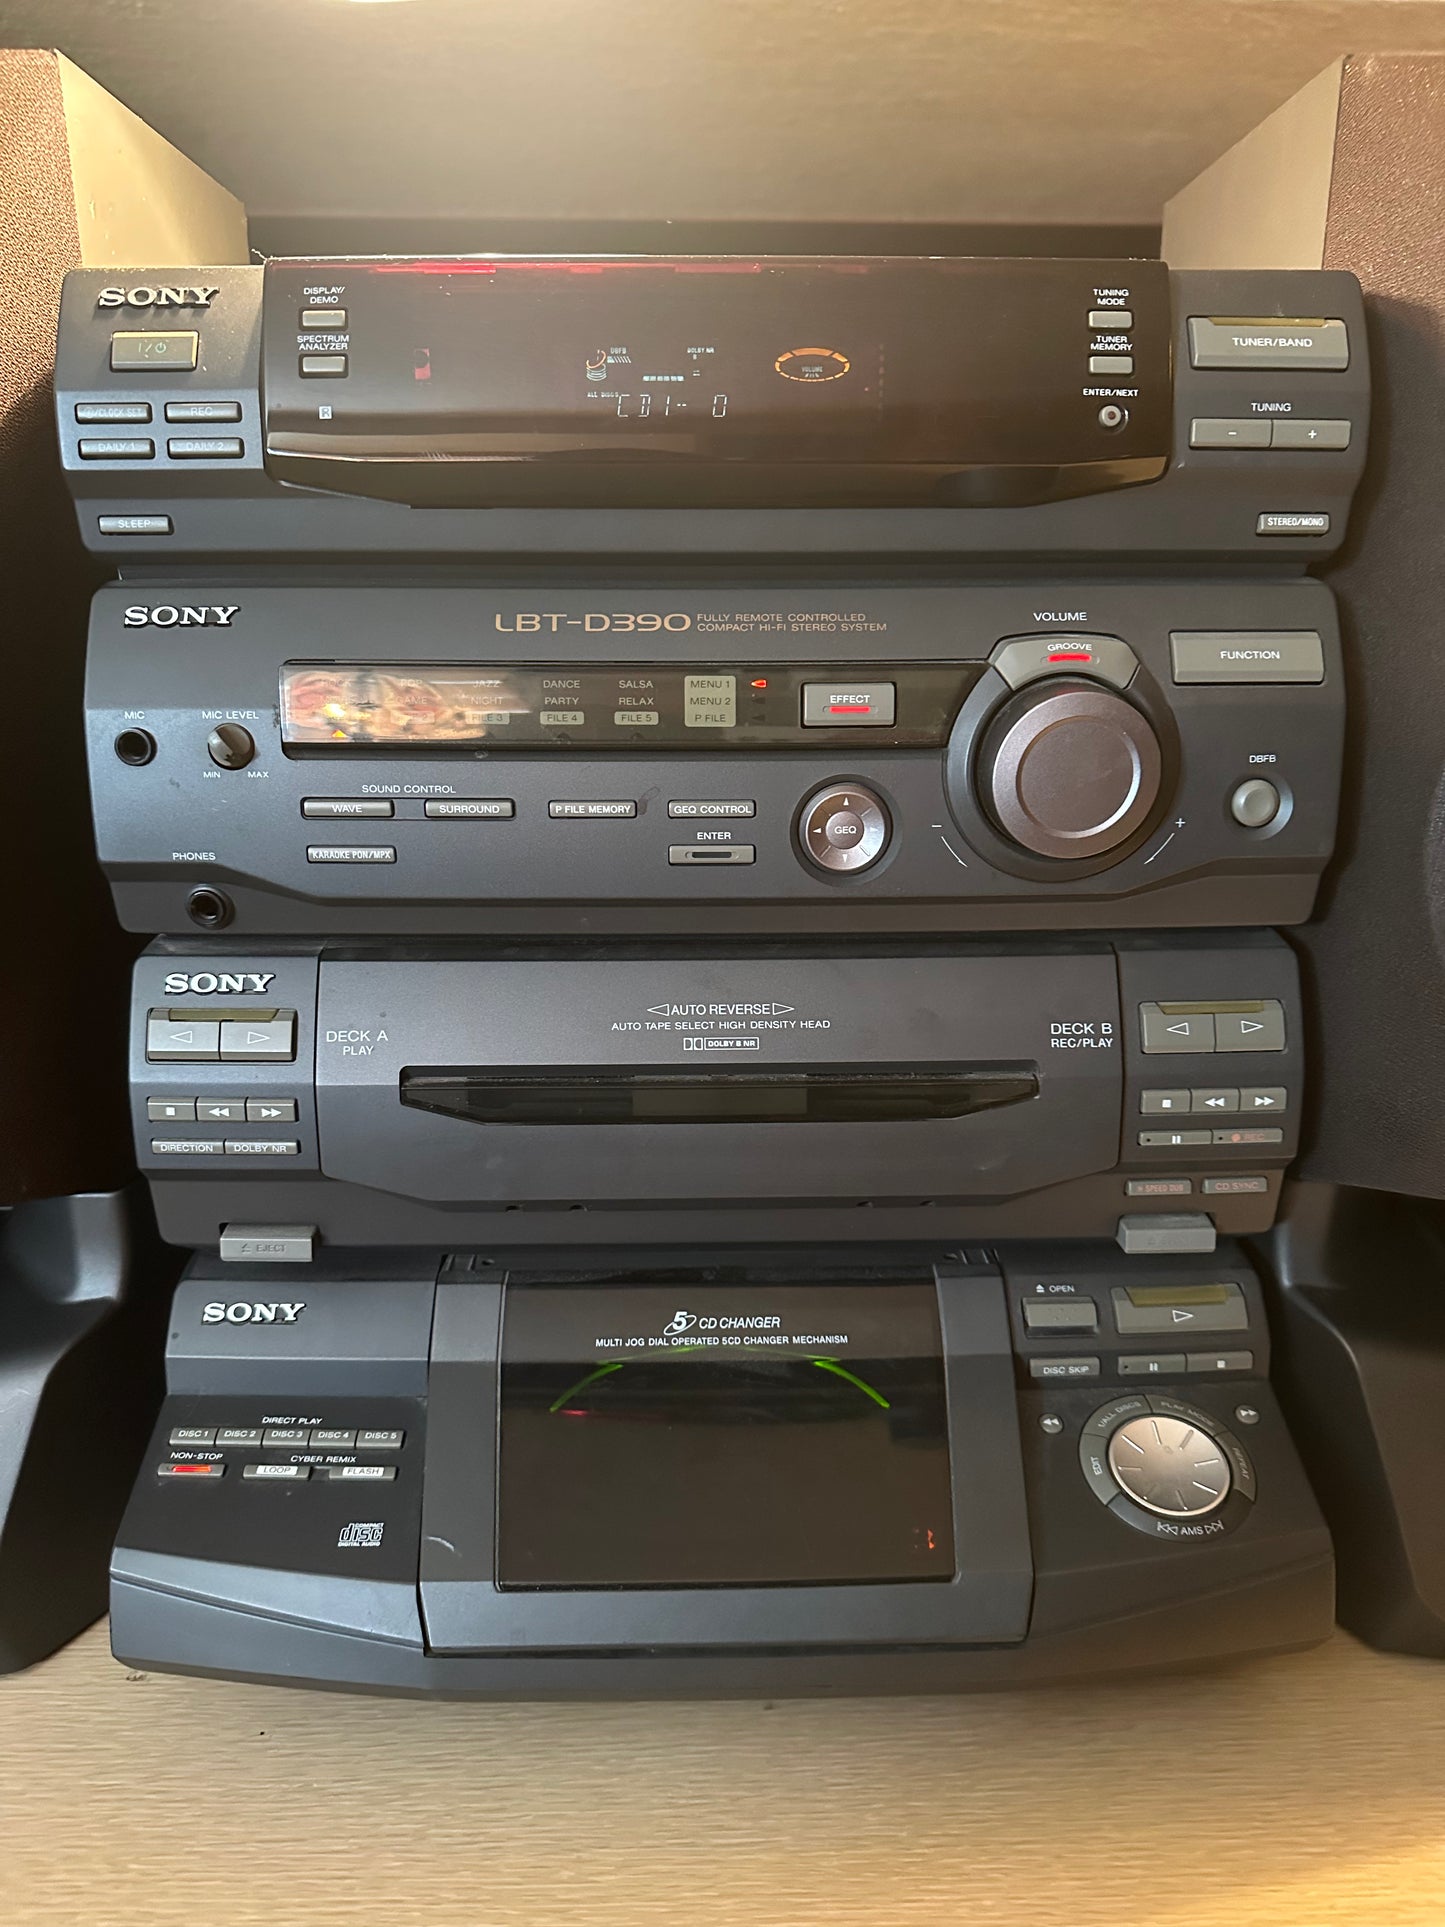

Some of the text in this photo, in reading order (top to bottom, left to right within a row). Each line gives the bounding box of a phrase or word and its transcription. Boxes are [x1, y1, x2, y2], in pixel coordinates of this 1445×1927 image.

[303, 287, 344, 295] DISPLAY/
[99, 287, 219, 307] SONY
[1090, 343, 1132, 351] MEMORY
[1232, 338, 1312, 347] TUNER/BAND
[1083, 389, 1138, 397] ENTER/NEXT
[126, 408, 142, 416] SET
[191, 407, 213, 416] REC
[1251, 403, 1291, 412] TUNING
[99, 444, 126, 452] DAILY
[217, 442, 224, 450] 2
[118, 519, 151, 528] SLEEP
[1268, 517, 1324, 527] STEREO/MONO
[124, 606, 238, 626] SONY
[697, 613, 865, 622] FULLY REMOTE CONTROLLED
[1034, 612, 1087, 622] VOLUME
[496, 614, 691, 632] LBT-D390
[697, 623, 887, 632] COMPACT HI-FI STEREO SYSTEM
[1047, 642, 1092, 652] GROOVE
[1220, 650, 1280, 660] FUNCTION
[472, 680, 500, 688] JAZZ
[619, 680, 653, 688] SALSA
[471, 697, 503, 705] NIGHT
[545, 697, 579, 705] PARTY
[830, 694, 870, 704] EFFECT
[124, 711, 144, 719] MIC
[202, 711, 259, 719] MIC LEVEL
[547, 714, 577, 722] FILE 4
[622, 714, 652, 722] FILE 5
[695, 714, 726, 722] P FILE
[1249, 754, 1276, 763] DBFB
[362, 784, 456, 794] SOUND CONTROL
[439, 804, 500, 814] SURROUND
[556, 805, 631, 815] P FILE MEMORY
[674, 804, 752, 815] GEQ CONTROL
[834, 825, 857, 836] GEQ
[697, 831, 731, 840] ENTER
[172, 852, 216, 861] PHONES
[313, 851, 391, 859] KARAOKE PON/MPX
[165, 974, 274, 993] SONY
[671, 1004, 770, 1015] AUTO REVERSE
[612, 1020, 830, 1031] AUTO TAPE SELECT HIGH DENSITY HEAD
[1051, 1023, 1112, 1035] DECK B
[326, 1030, 388, 1042] DECK A
[1051, 1038, 1113, 1048] REC/PLAY
[343, 1046, 374, 1055] PLAY
[1243, 1133, 1264, 1141] REC
[160, 1144, 213, 1152] DIRECTION
[234, 1144, 267, 1152] DOLBY
[1232, 1182, 1258, 1190] SYNC
[256, 1244, 286, 1252] EJECT
[203, 1303, 305, 1322] SONY
[699, 1318, 717, 1329] CD
[719, 1317, 780, 1329] CHANGER
[596, 1335, 848, 1346] MULTI JOG DIAL OPERATED 5CD CHANGER MECHANISM
[1090, 1456, 1103, 1475] EDIT
[339, 1523, 383, 1541] disc
[1181, 1526, 1204, 1535] AMS
